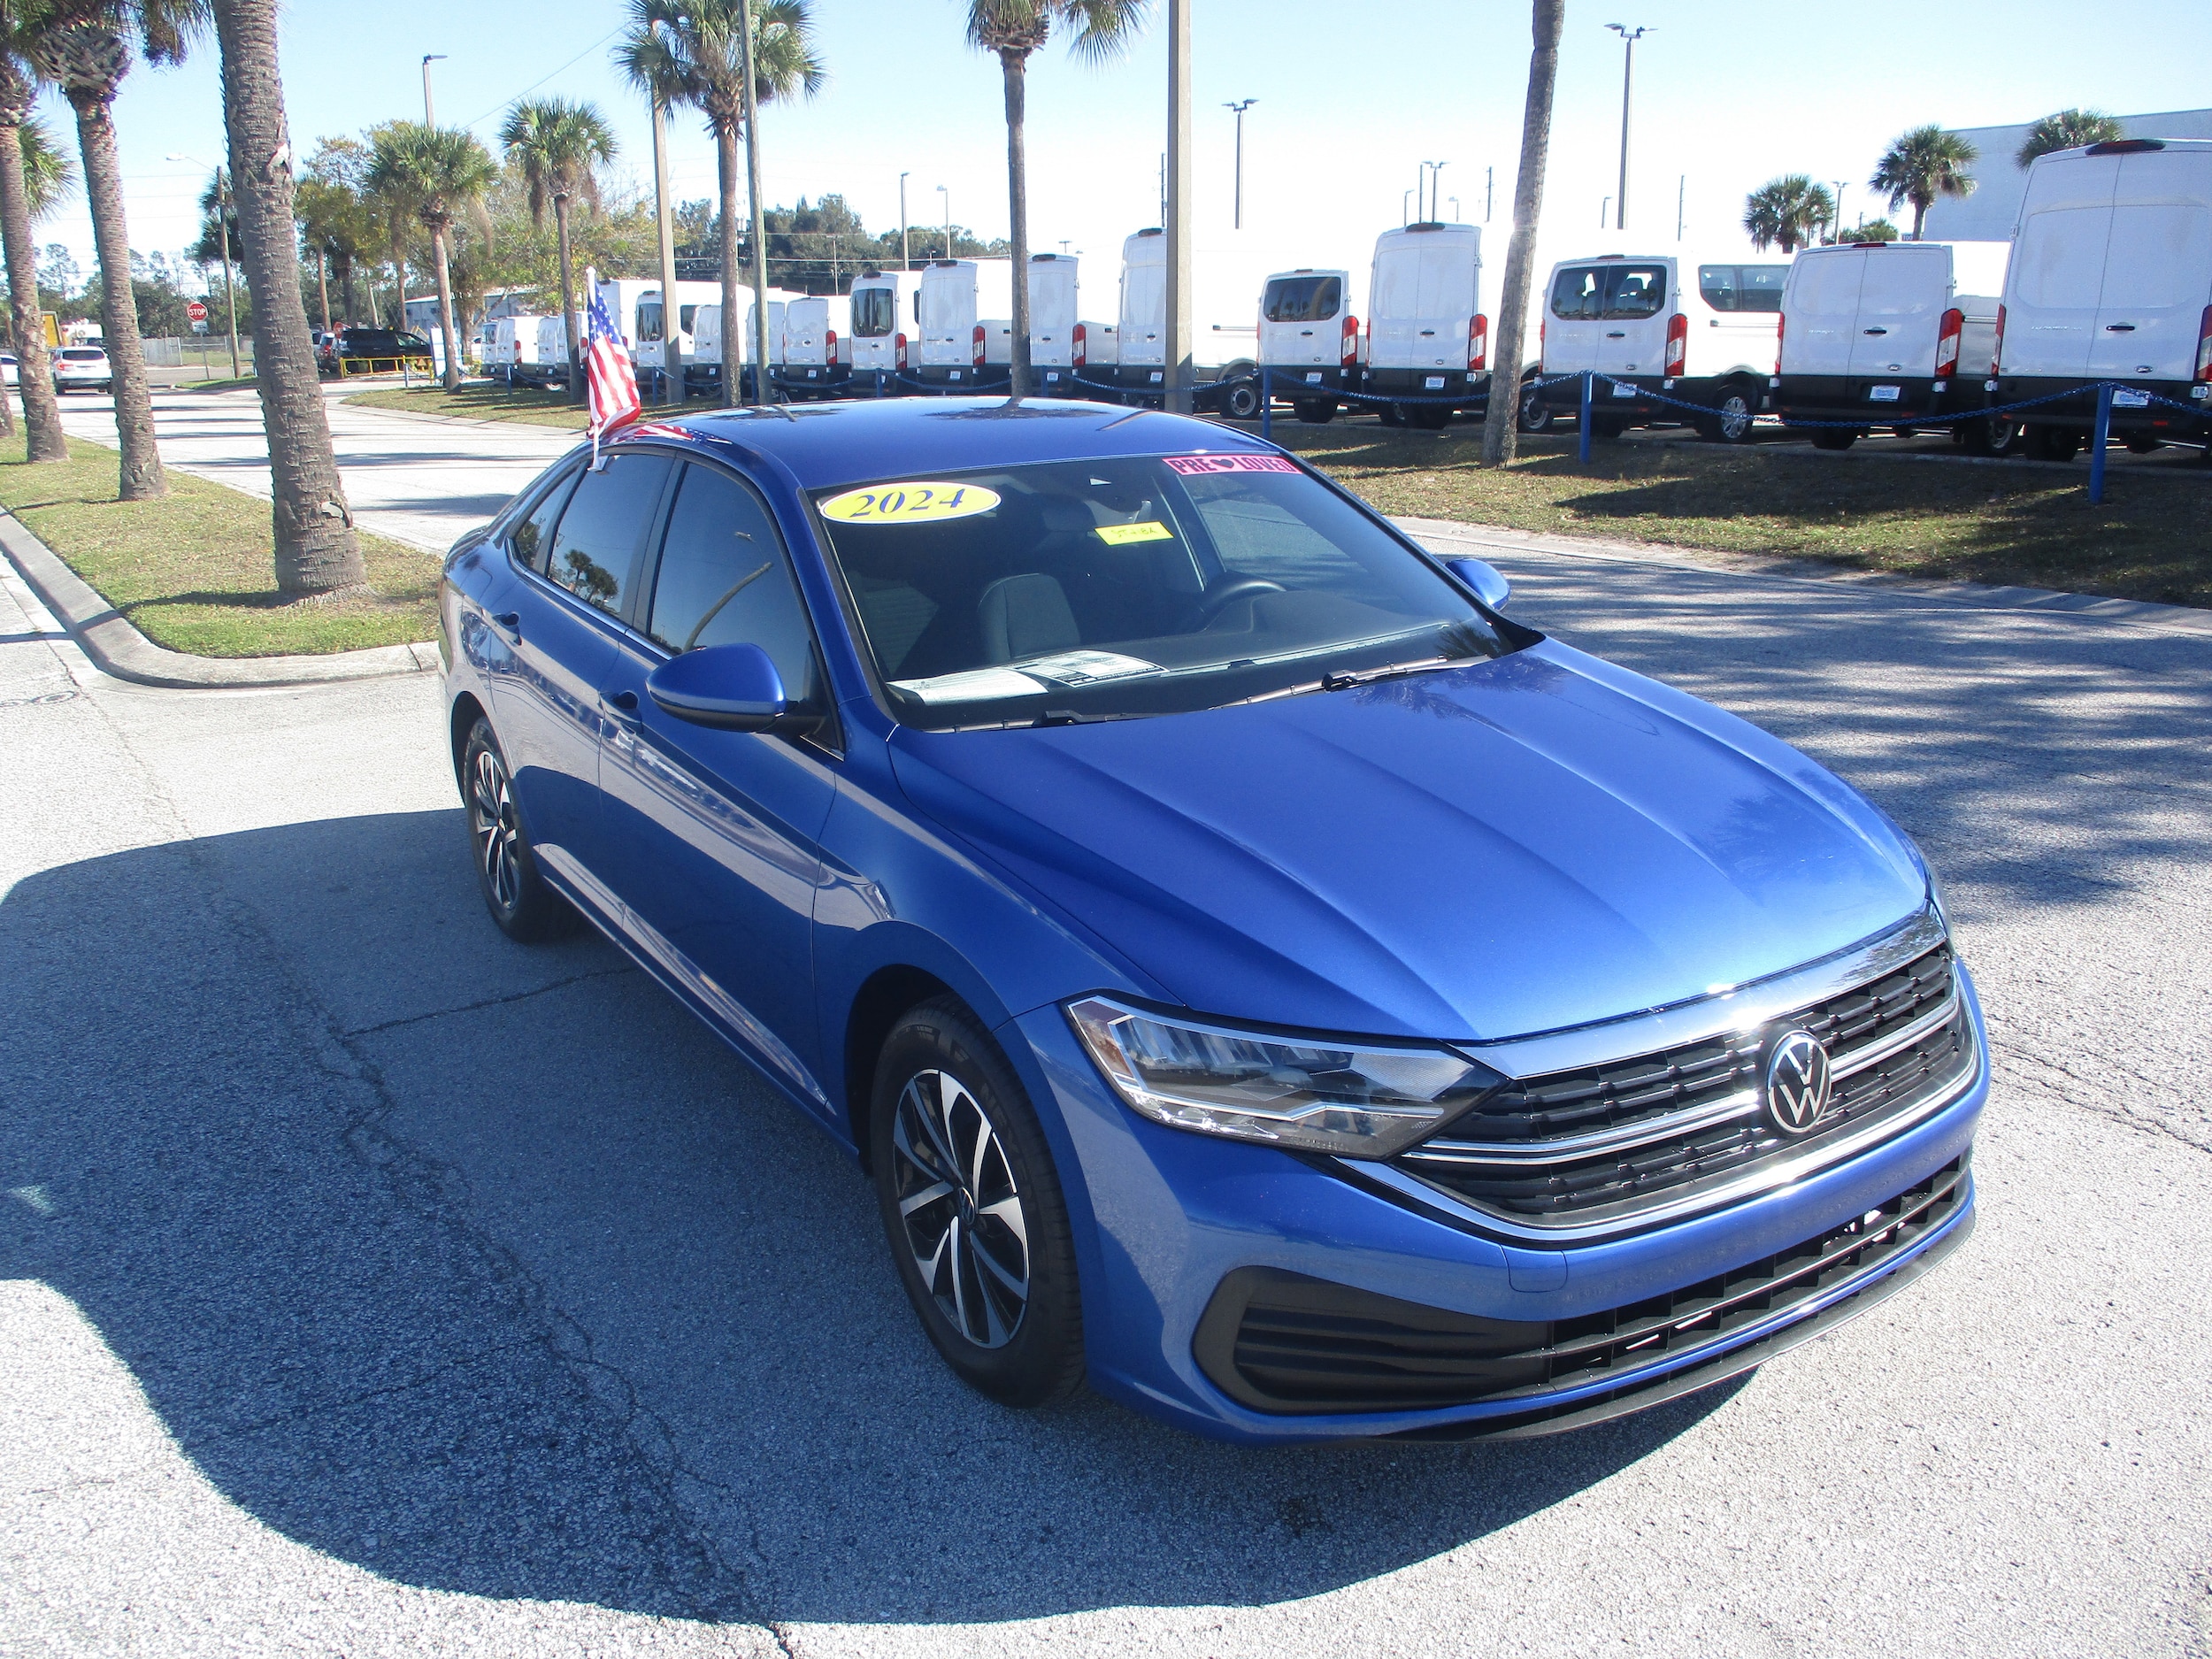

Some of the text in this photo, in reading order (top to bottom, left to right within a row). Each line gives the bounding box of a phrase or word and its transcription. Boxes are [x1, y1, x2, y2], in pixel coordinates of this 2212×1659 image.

[188, 308, 205, 317] STOP
[1169, 457, 1296, 472] PRE LOVED
[849, 488, 965, 518] 2024
[1771, 1034, 1828, 1126] VW
